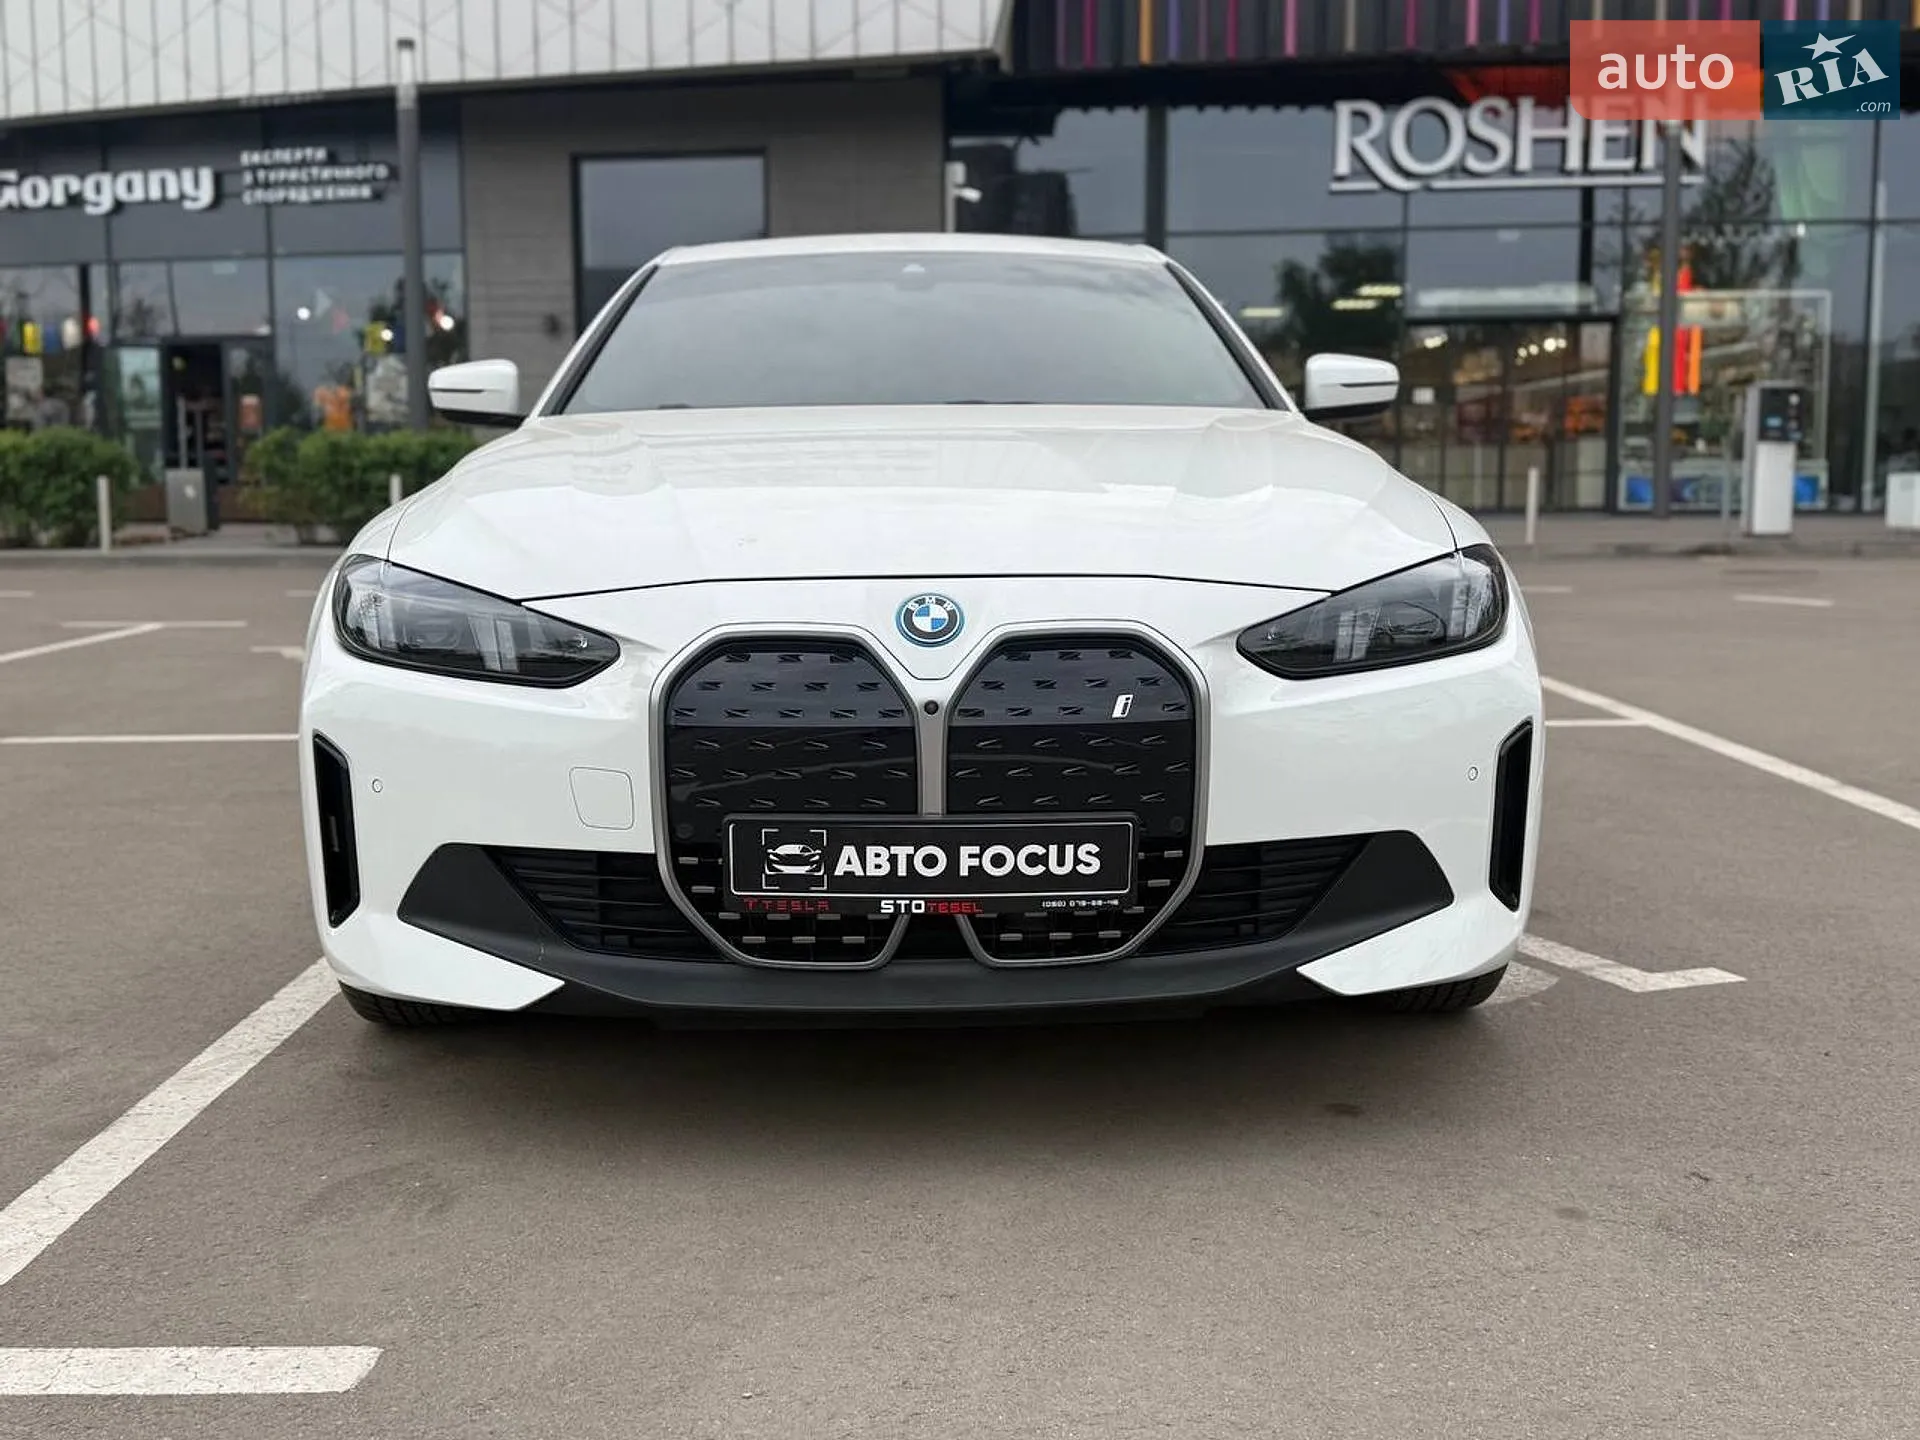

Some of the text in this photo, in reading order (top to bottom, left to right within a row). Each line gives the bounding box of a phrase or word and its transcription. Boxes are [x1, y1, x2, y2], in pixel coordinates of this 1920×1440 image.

[1333, 96, 1705, 191] ROSHEN
[907, 596, 954, 612] BMW
[958, 843, 1102, 878] FOCUS
